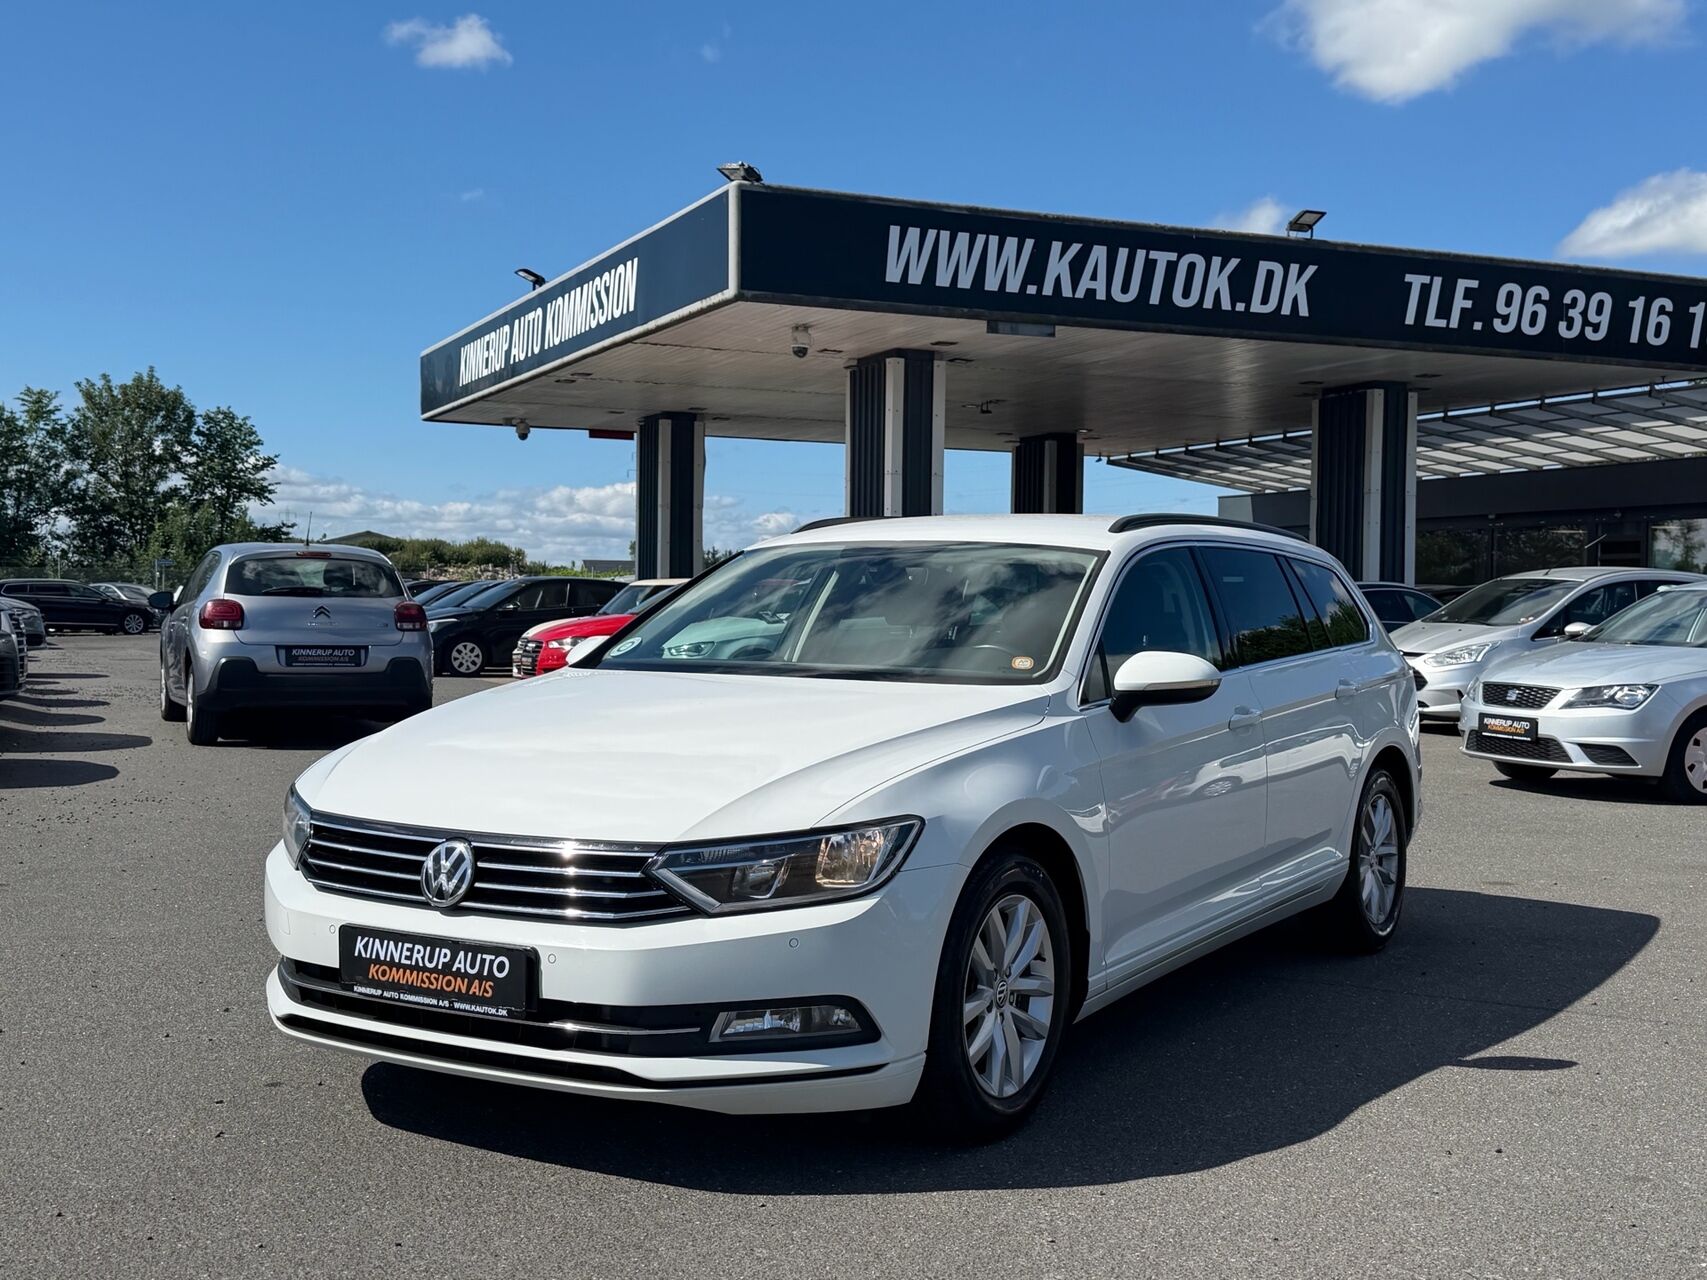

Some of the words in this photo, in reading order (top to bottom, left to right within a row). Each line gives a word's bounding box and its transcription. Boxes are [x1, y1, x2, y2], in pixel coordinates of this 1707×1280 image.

[885, 225, 1318, 317] WWW.KAUTOK.DK
[459, 324, 510, 387] KINNERUP
[510, 306, 543, 364] AUTO
[544, 257, 638, 350] KOMMISSION
[1404, 273, 1483, 331] TLF.
[1493, 282, 1550, 336] 96
[1558, 289, 1612, 341] 39
[1628, 295, 1673, 346] 16
[1688, 301, 1707, 349] 1
[1513, 721, 1530, 729] AUTO
[354, 935, 451, 970] KINNERUP
[452, 950, 510, 978] AUTO
[353, 985, 382, 997] KINNERUP
[382, 990, 399, 999] AUTO
[399, 993, 438, 1006] KOMMISSION
[453, 1001, 508, 1017] WWW.KAUTOK.DK
[368, 963, 468, 994] KOMMISSION
[469, 978, 494, 998] A/S
